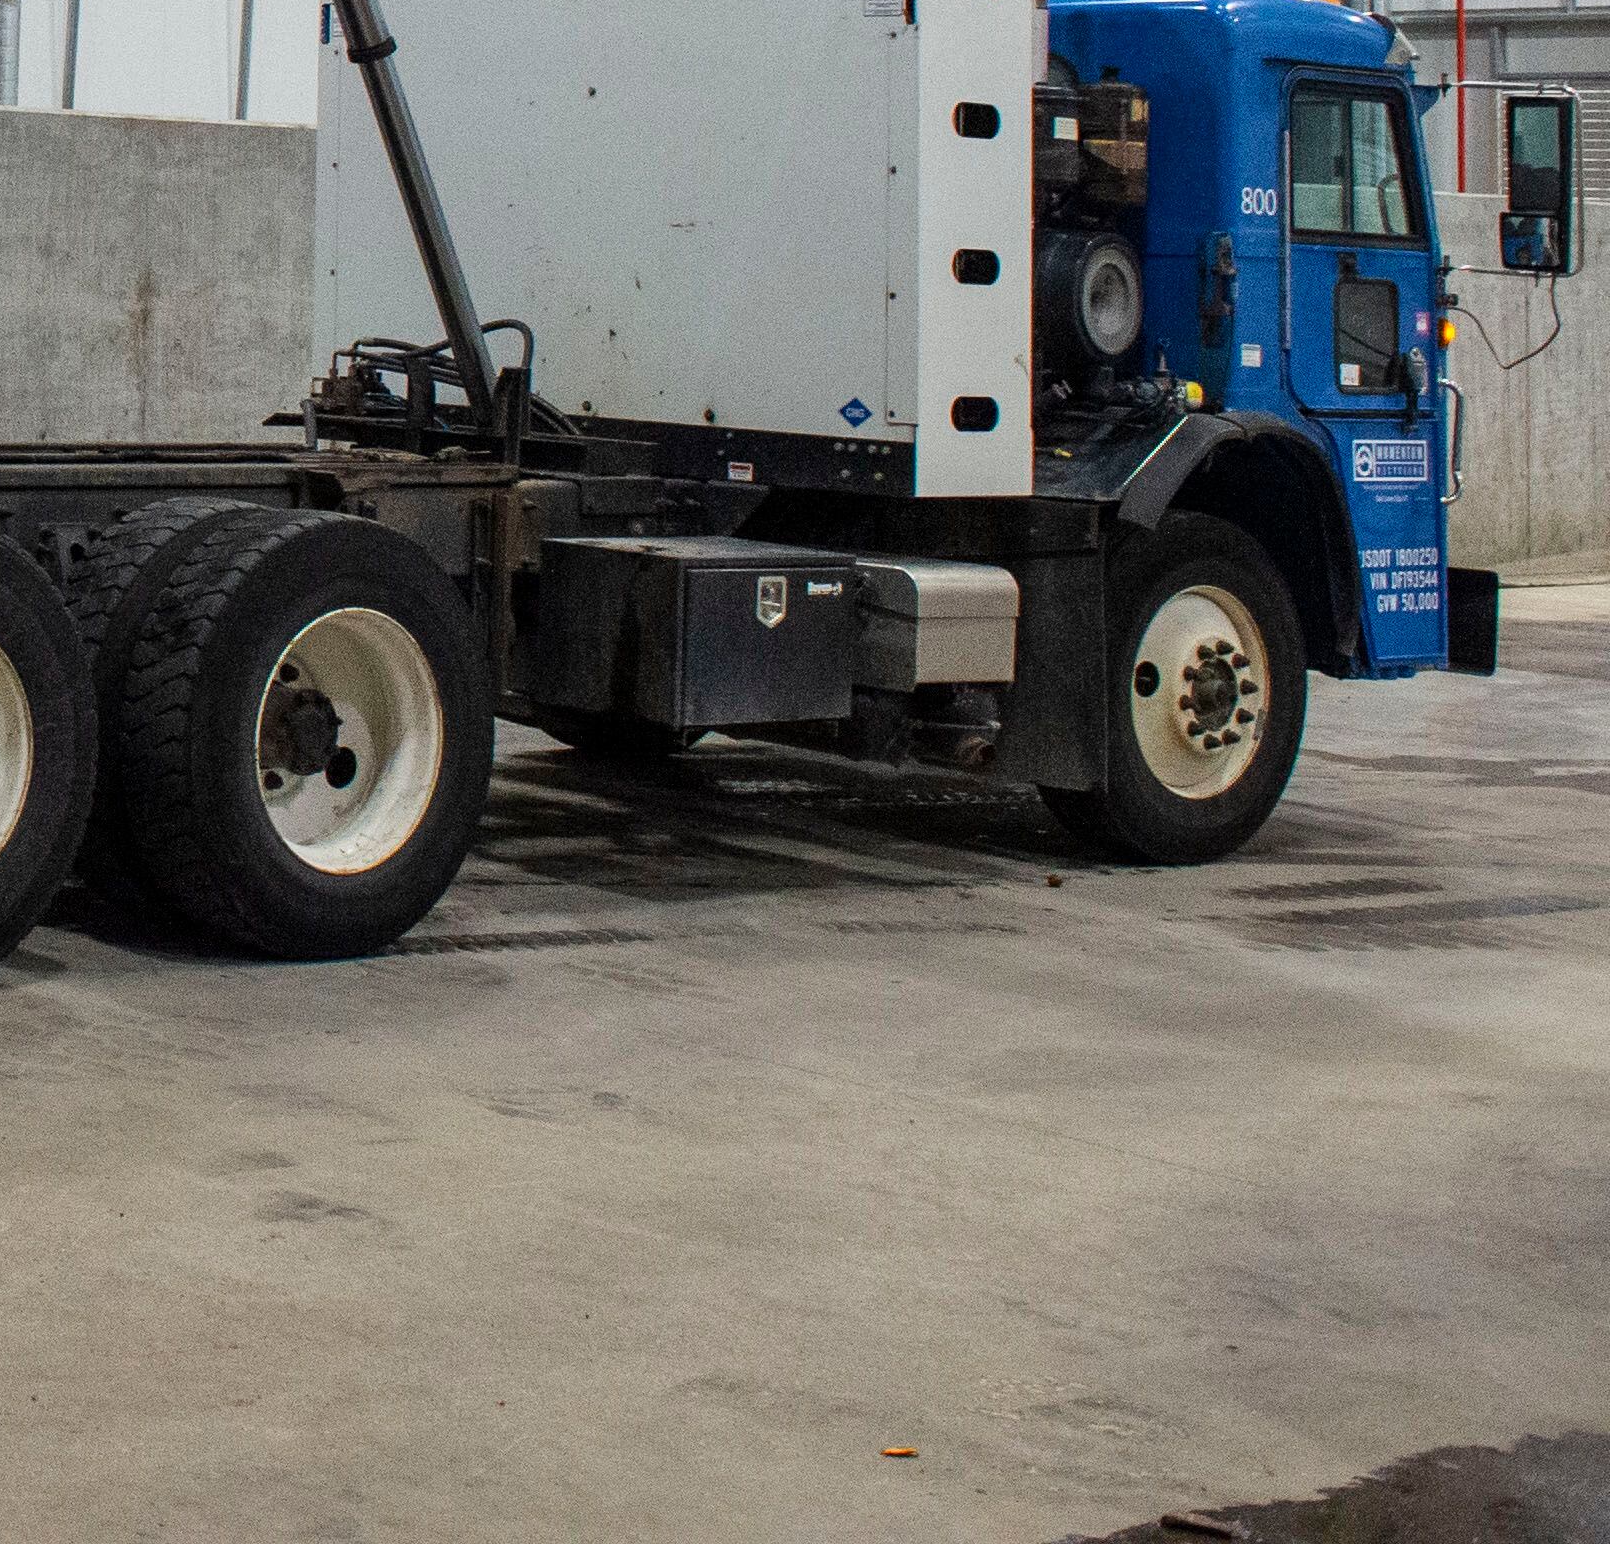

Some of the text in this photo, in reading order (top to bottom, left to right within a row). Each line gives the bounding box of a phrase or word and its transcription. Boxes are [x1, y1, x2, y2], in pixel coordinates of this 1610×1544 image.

[1241, 187, 1278, 216] 800
[1375, 445, 1424, 461] MOMENTUM
[1376, 594, 1398, 613] GVW
